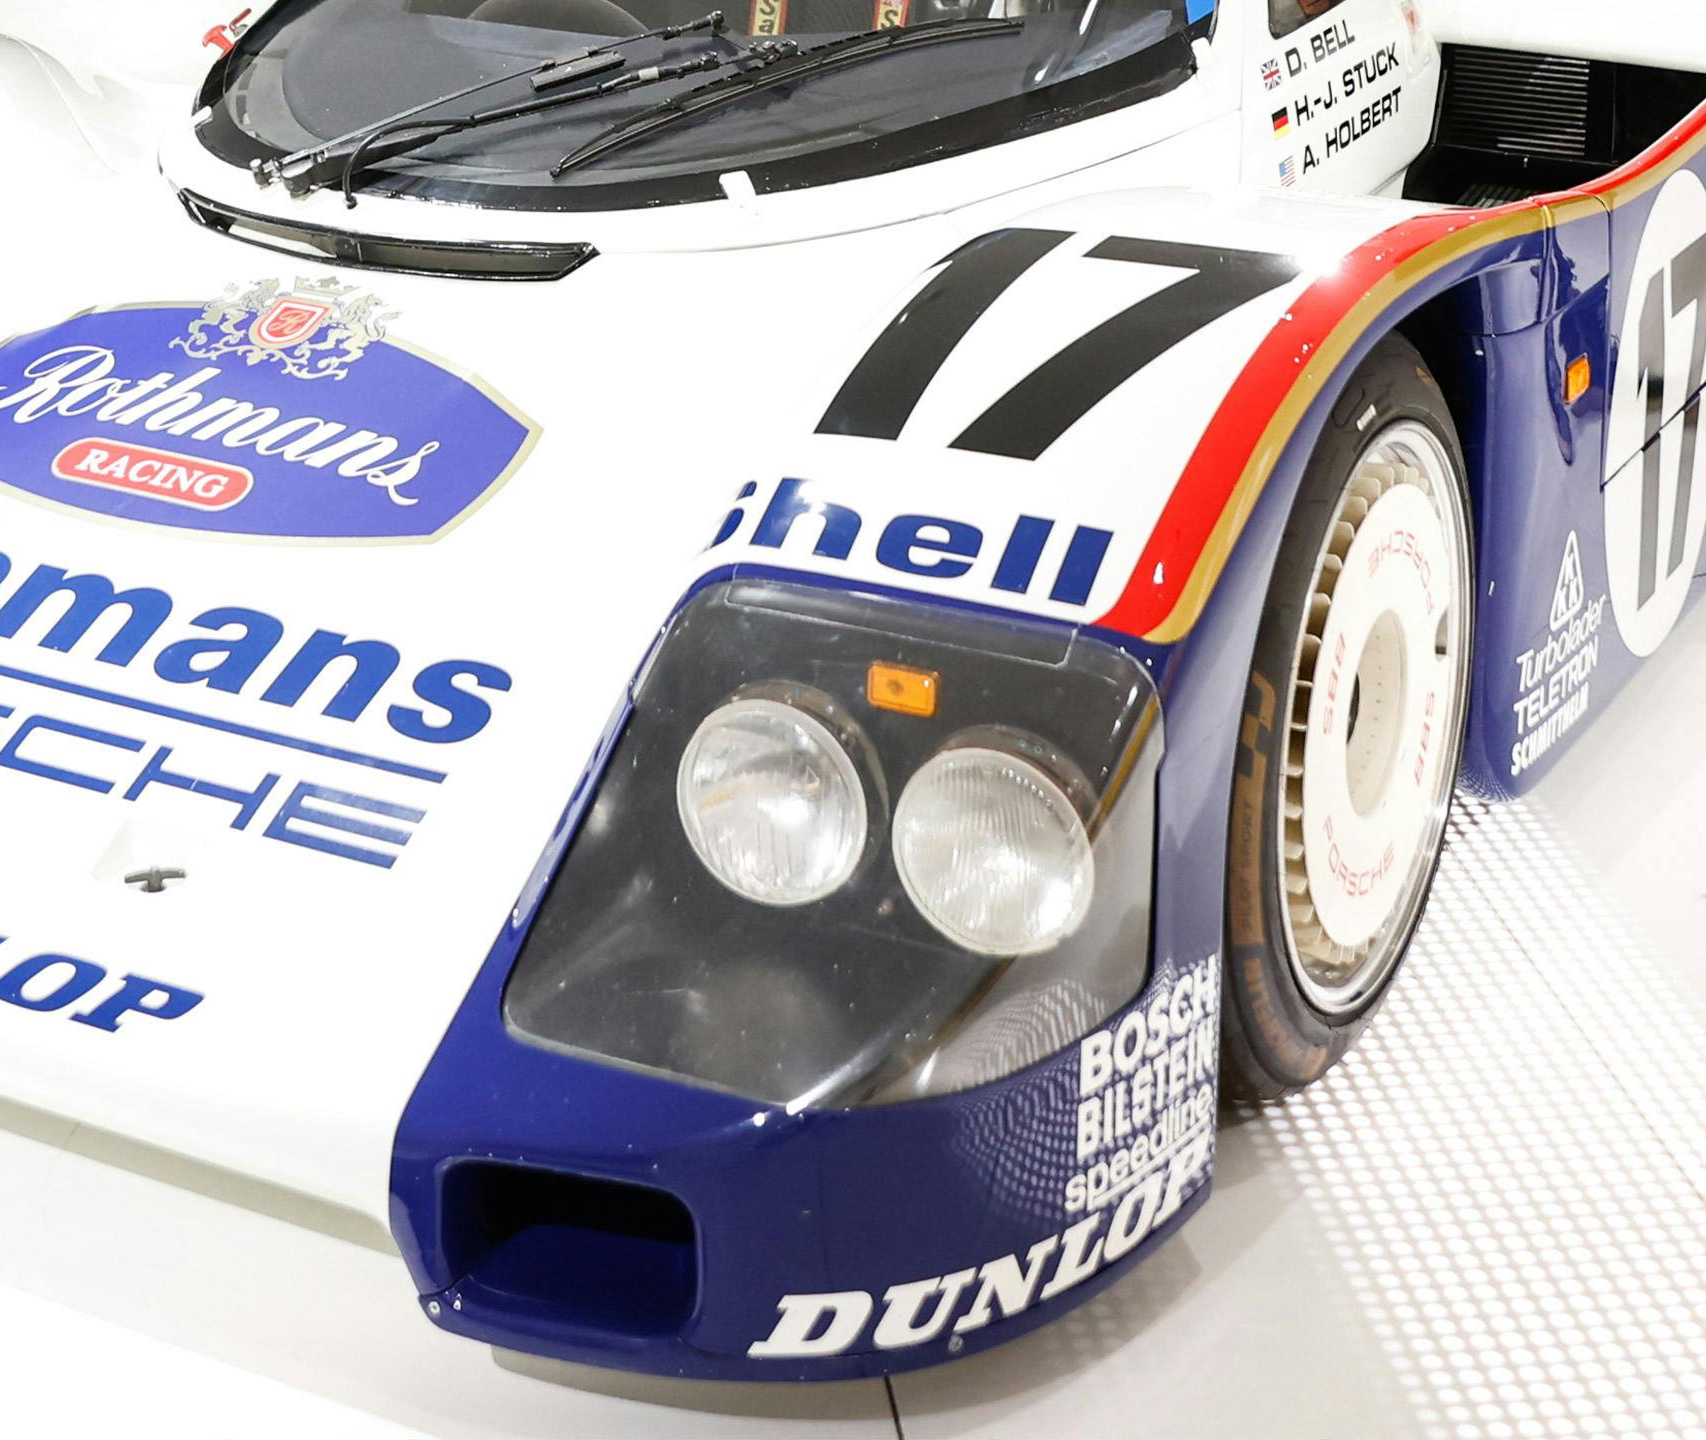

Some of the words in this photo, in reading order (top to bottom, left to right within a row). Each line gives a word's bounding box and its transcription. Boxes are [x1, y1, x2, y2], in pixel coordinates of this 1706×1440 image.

[1284, 47, 1308, 79] D.
[1309, 19, 1357, 64] BELL
[1294, 80, 1338, 127] H.-J.
[1341, 41, 1400, 98] STUCK
[1302, 144, 1321, 175] A.
[1324, 85, 1402, 158] HOLBERT
[812, 226, 1303, 462] 17
[75, 448, 230, 498] RACING
[1513, 635, 1599, 735] TELETRON
[1516, 593, 1607, 693] Turbolader
[1322, 814, 1395, 898] PORSCHE
[1080, 953, 1218, 1098] BOSCH
[1077, 1016, 1215, 1165] BILSTEIN
[1064, 1083, 1214, 1212] speedline
[746, 1127, 1211, 1359] DUNLOP
